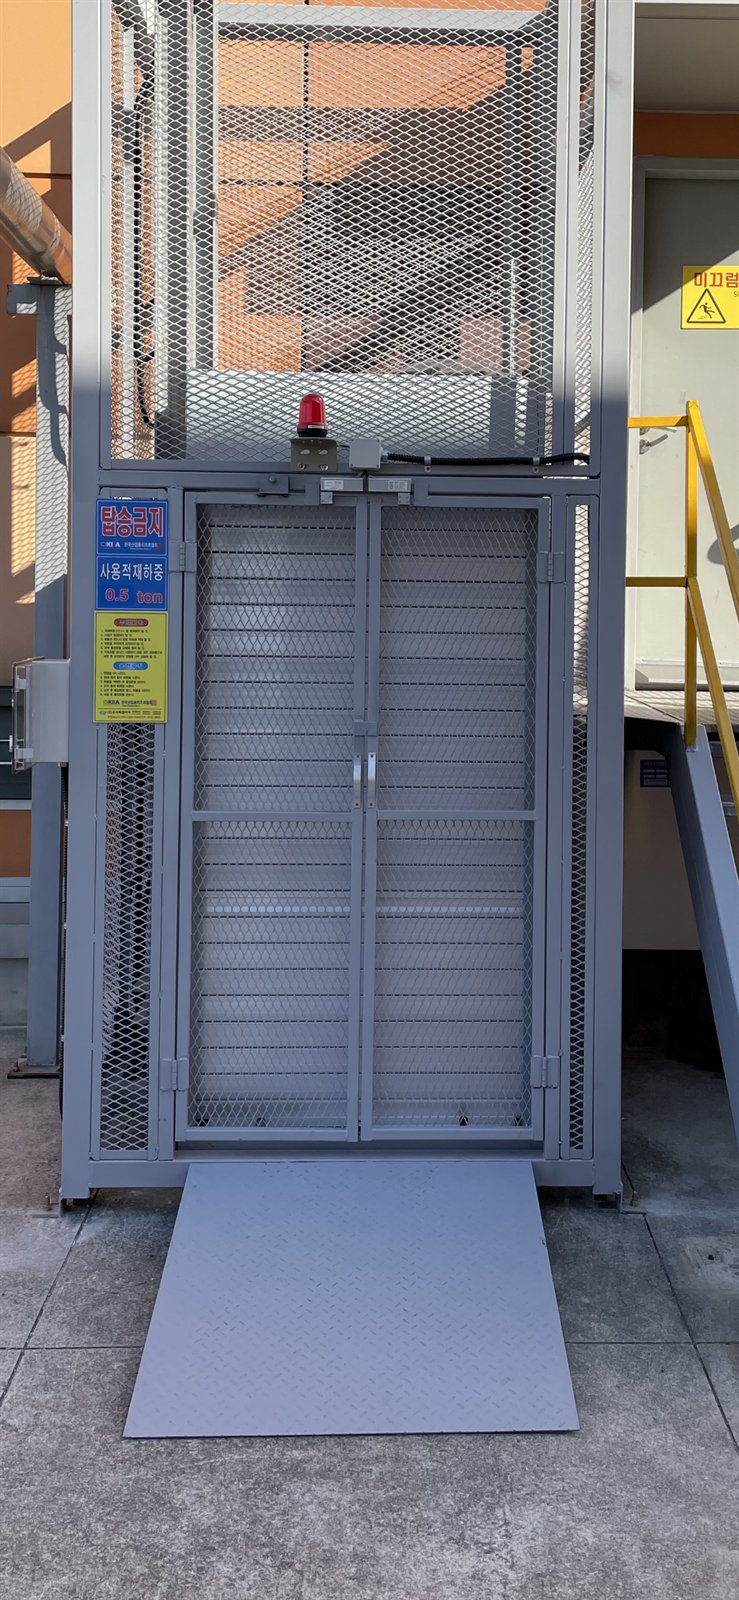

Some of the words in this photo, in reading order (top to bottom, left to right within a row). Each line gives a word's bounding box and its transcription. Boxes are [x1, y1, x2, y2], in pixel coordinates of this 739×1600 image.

[101, 506, 163, 537] 탑승금지
[100, 562, 164, 581] 사용적재하중
[105, 588, 129, 602] 0.5
[137, 590, 164, 604] ton
